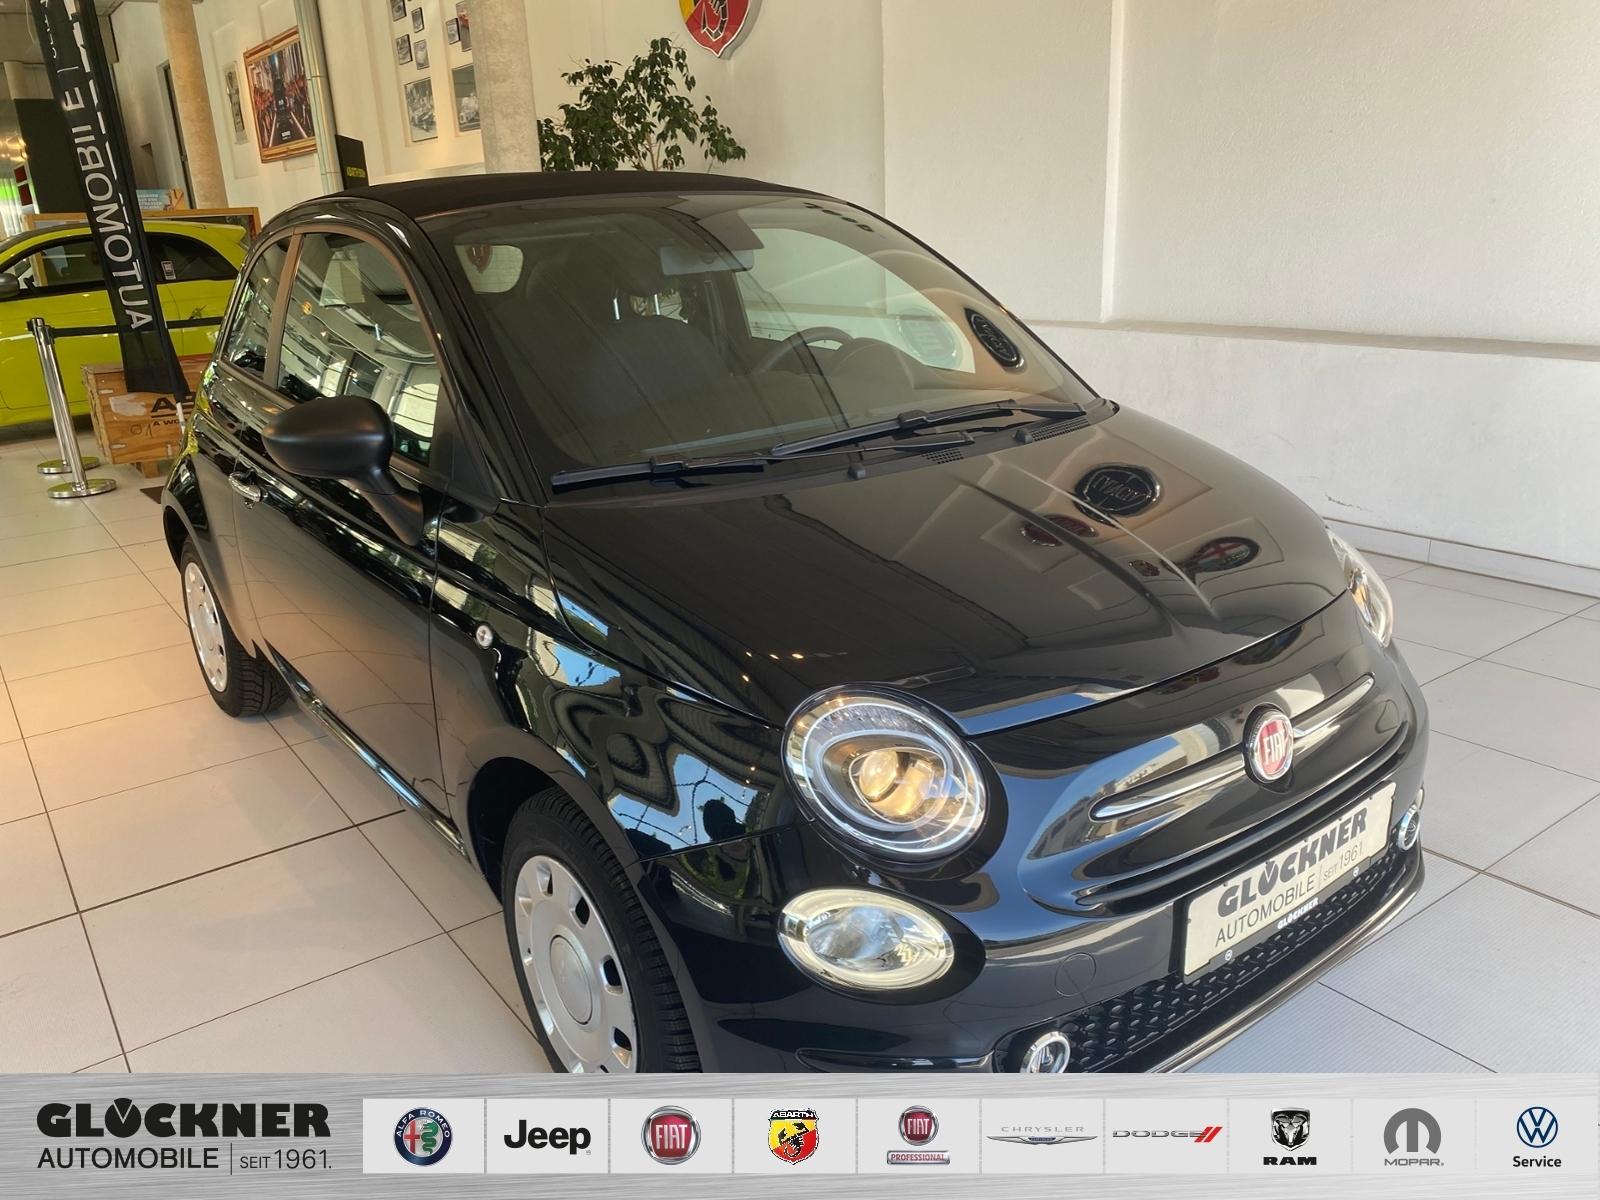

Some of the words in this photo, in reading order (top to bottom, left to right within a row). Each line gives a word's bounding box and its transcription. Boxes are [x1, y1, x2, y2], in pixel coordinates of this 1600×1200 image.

[1262, 726, 1289, 766] FIAT
[1215, 873, 1315, 947] AUTOMOBILE
[1323, 864, 1338, 880] SEIT
